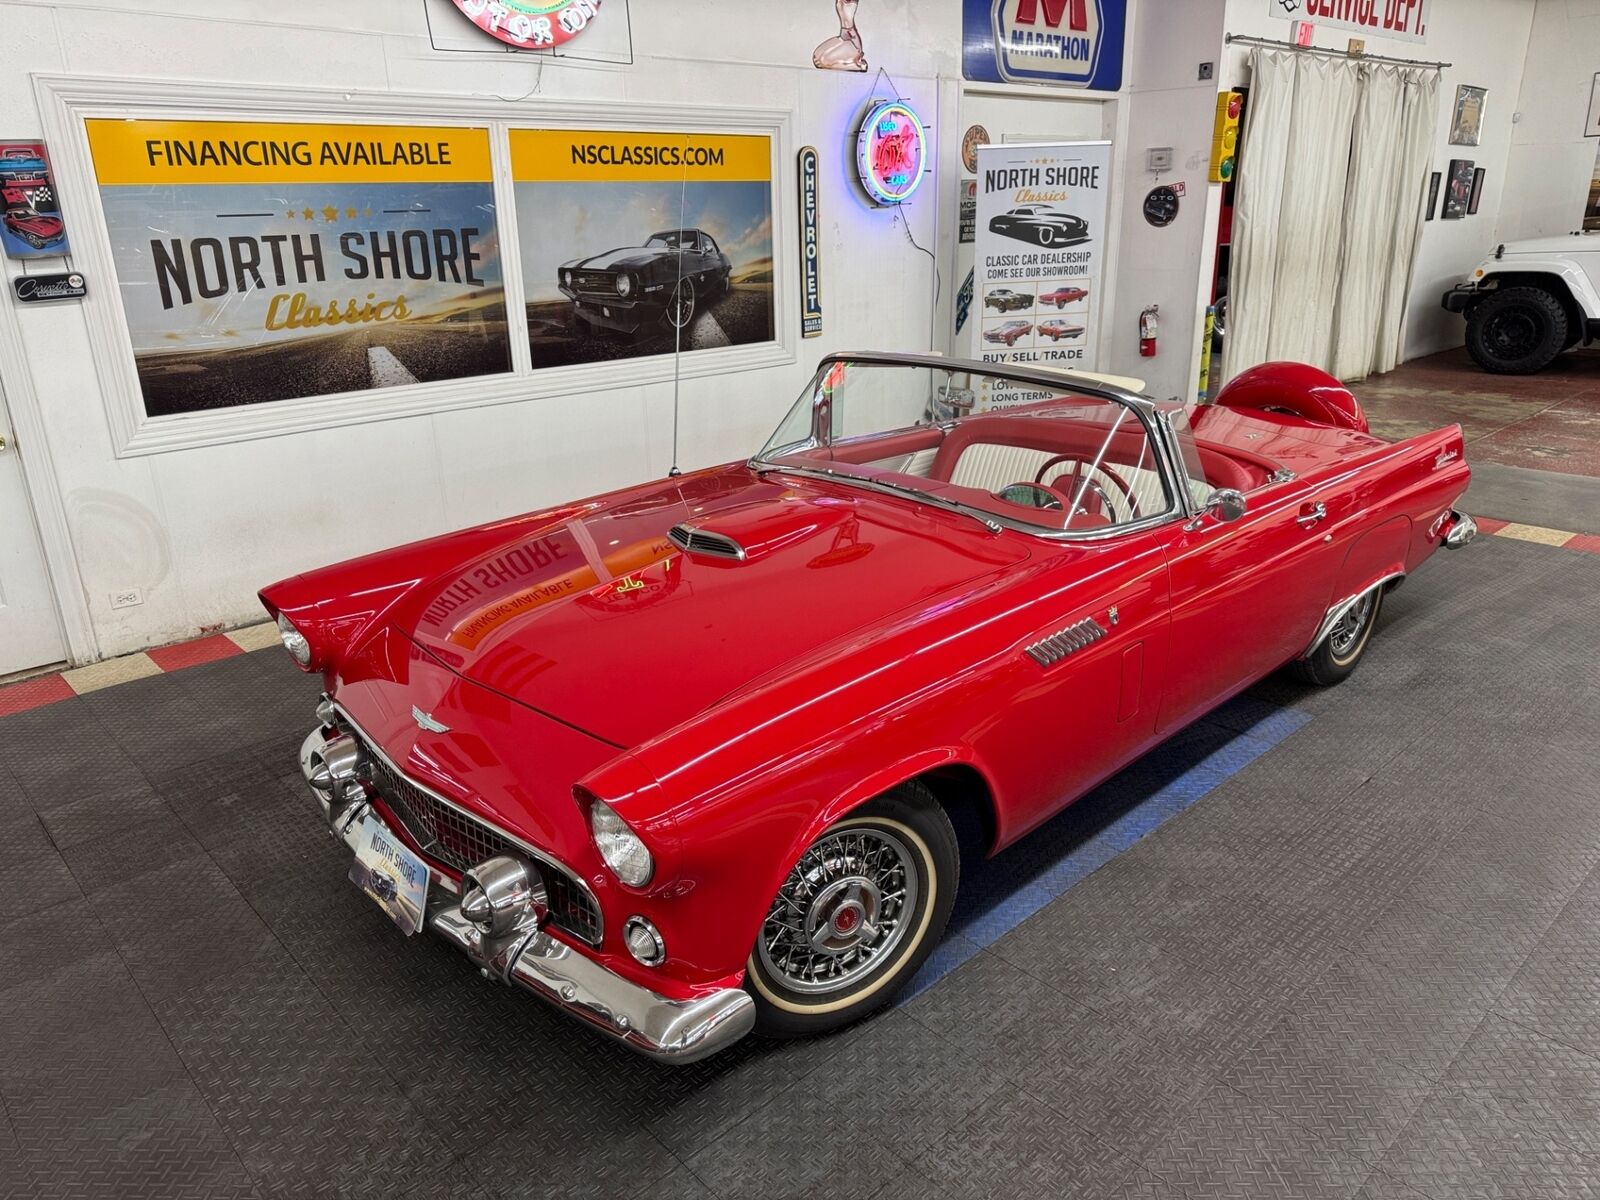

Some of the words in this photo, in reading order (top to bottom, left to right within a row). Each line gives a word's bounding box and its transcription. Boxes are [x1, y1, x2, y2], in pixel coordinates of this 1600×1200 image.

[1011, 30, 1090, 62] MARATHON
[145, 139, 313, 167] FINANCING
[319, 141, 452, 167] AVAILABLE
[571, 144, 725, 167] NSCLASSICS.COM
[985, 167, 1040, 194] NORTH
[1045, 165, 1100, 190] SHORE
[959, 201, 976, 209] MOP
[1014, 188, 1069, 203] Classics
[804, 157, 817, 310] CHEVROLET
[150, 232, 327, 310] NORTH
[339, 226, 485, 288] SHORE
[985, 254, 1020, 267] CLASSIC
[1021, 253, 1039, 266] CAR
[1040, 251, 1092, 265] DEALERSHIP
[987, 268, 1009, 279] COME
[1010, 267, 1024, 278] SEE
[1025, 266, 1041, 277] OUR
[1042, 265, 1088, 277] SHOWROOM!
[264, 291, 413, 332] Classics
[991, 392, 1019, 402] LONG
[1020, 391, 1053, 401] TERMS
[370, 832, 394, 862] NORTH
[393, 852, 417, 889] SHORE
